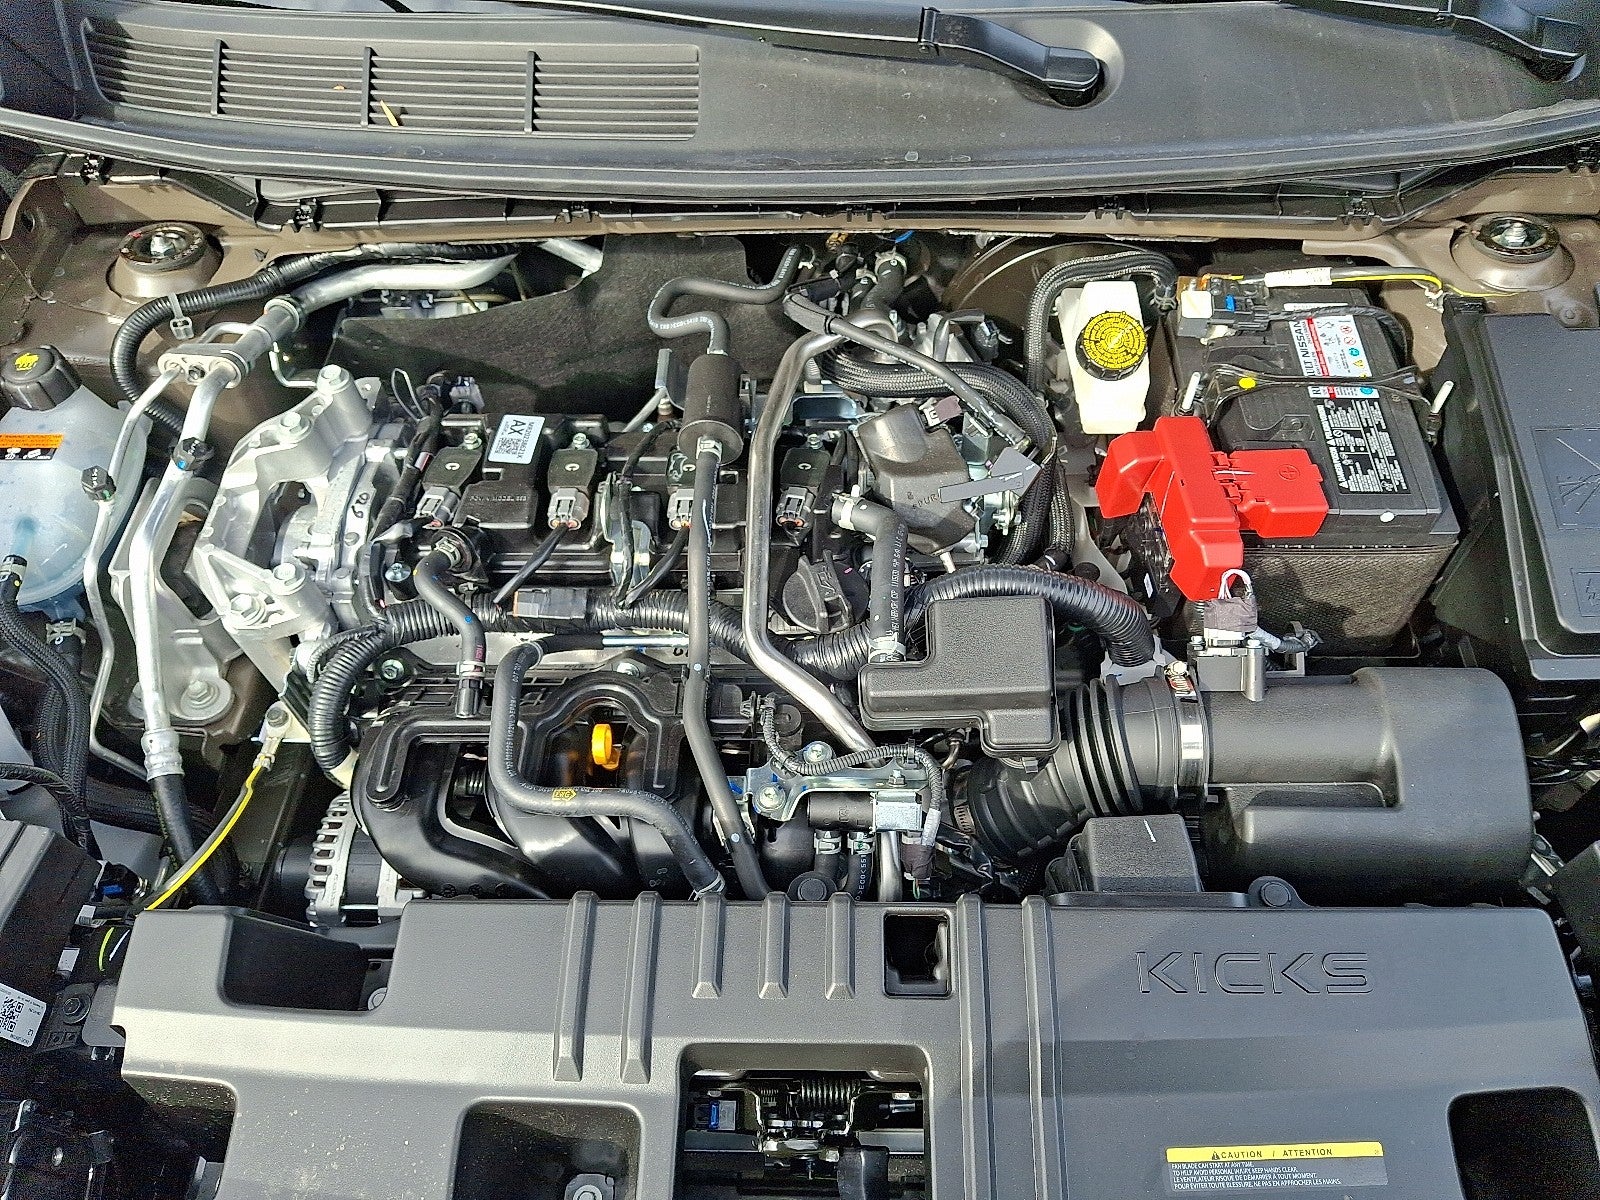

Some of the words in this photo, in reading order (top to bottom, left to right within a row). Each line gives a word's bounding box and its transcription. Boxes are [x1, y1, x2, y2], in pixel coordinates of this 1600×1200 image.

[1294, 320, 1310, 358] NISSAN
[508, 419, 526, 435] AX
[1136, 951, 1373, 994] KICKS
[1220, 1150, 1262, 1159] CAUTION
[1282, 1148, 1333, 1157] ATTENTION
